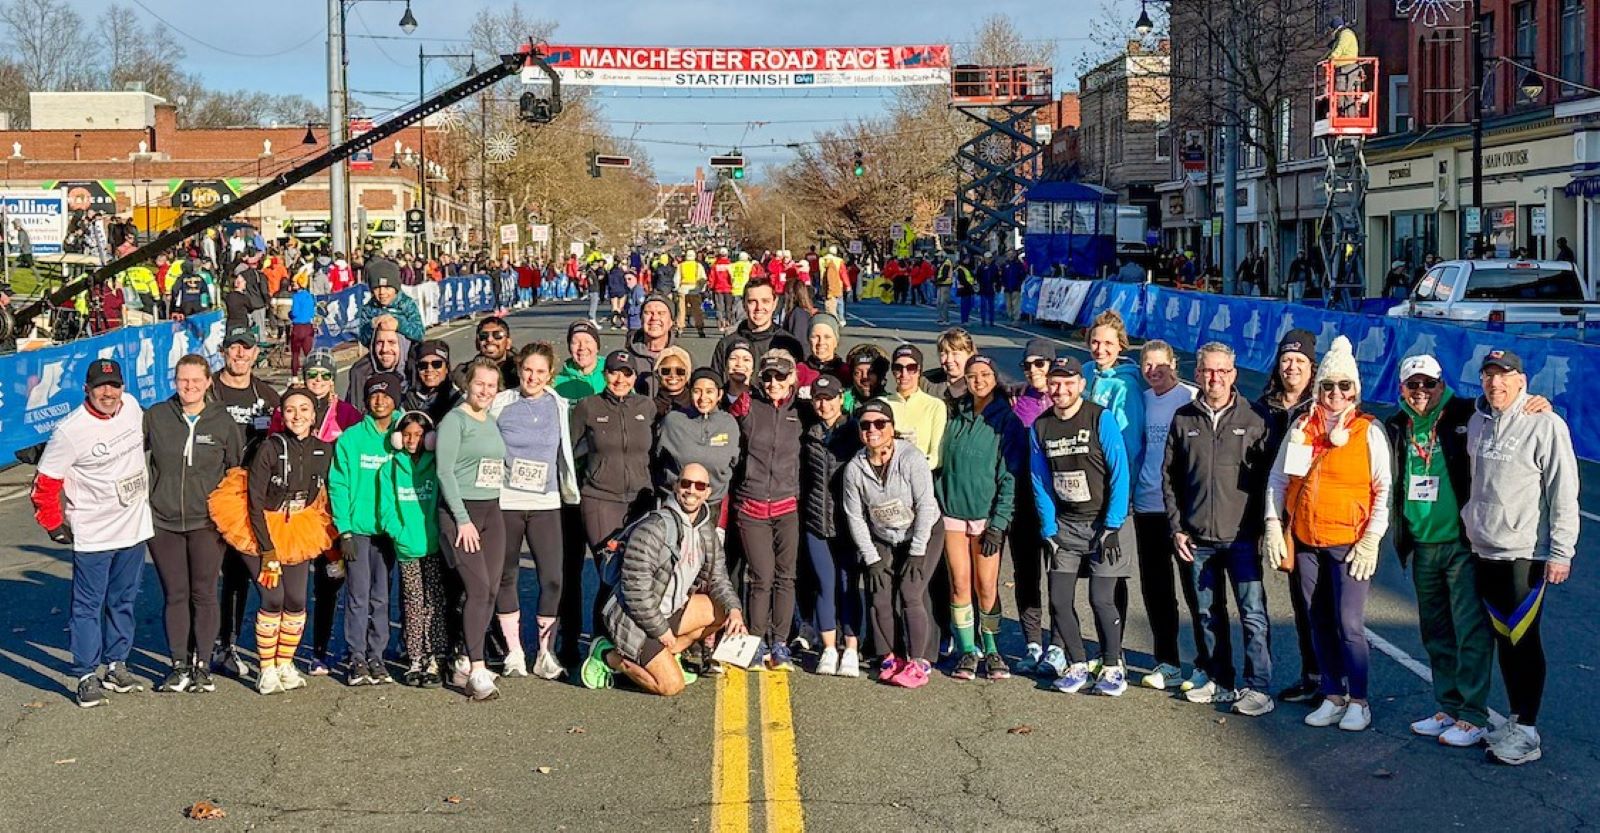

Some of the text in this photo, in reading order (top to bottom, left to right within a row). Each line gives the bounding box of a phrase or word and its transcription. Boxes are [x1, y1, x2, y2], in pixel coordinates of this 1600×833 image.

[579, 48, 891, 70] MANCHESTER ROAD RACE
[675, 72, 790, 86] START/FINISH
[518, 467, 542, 478] 6521
